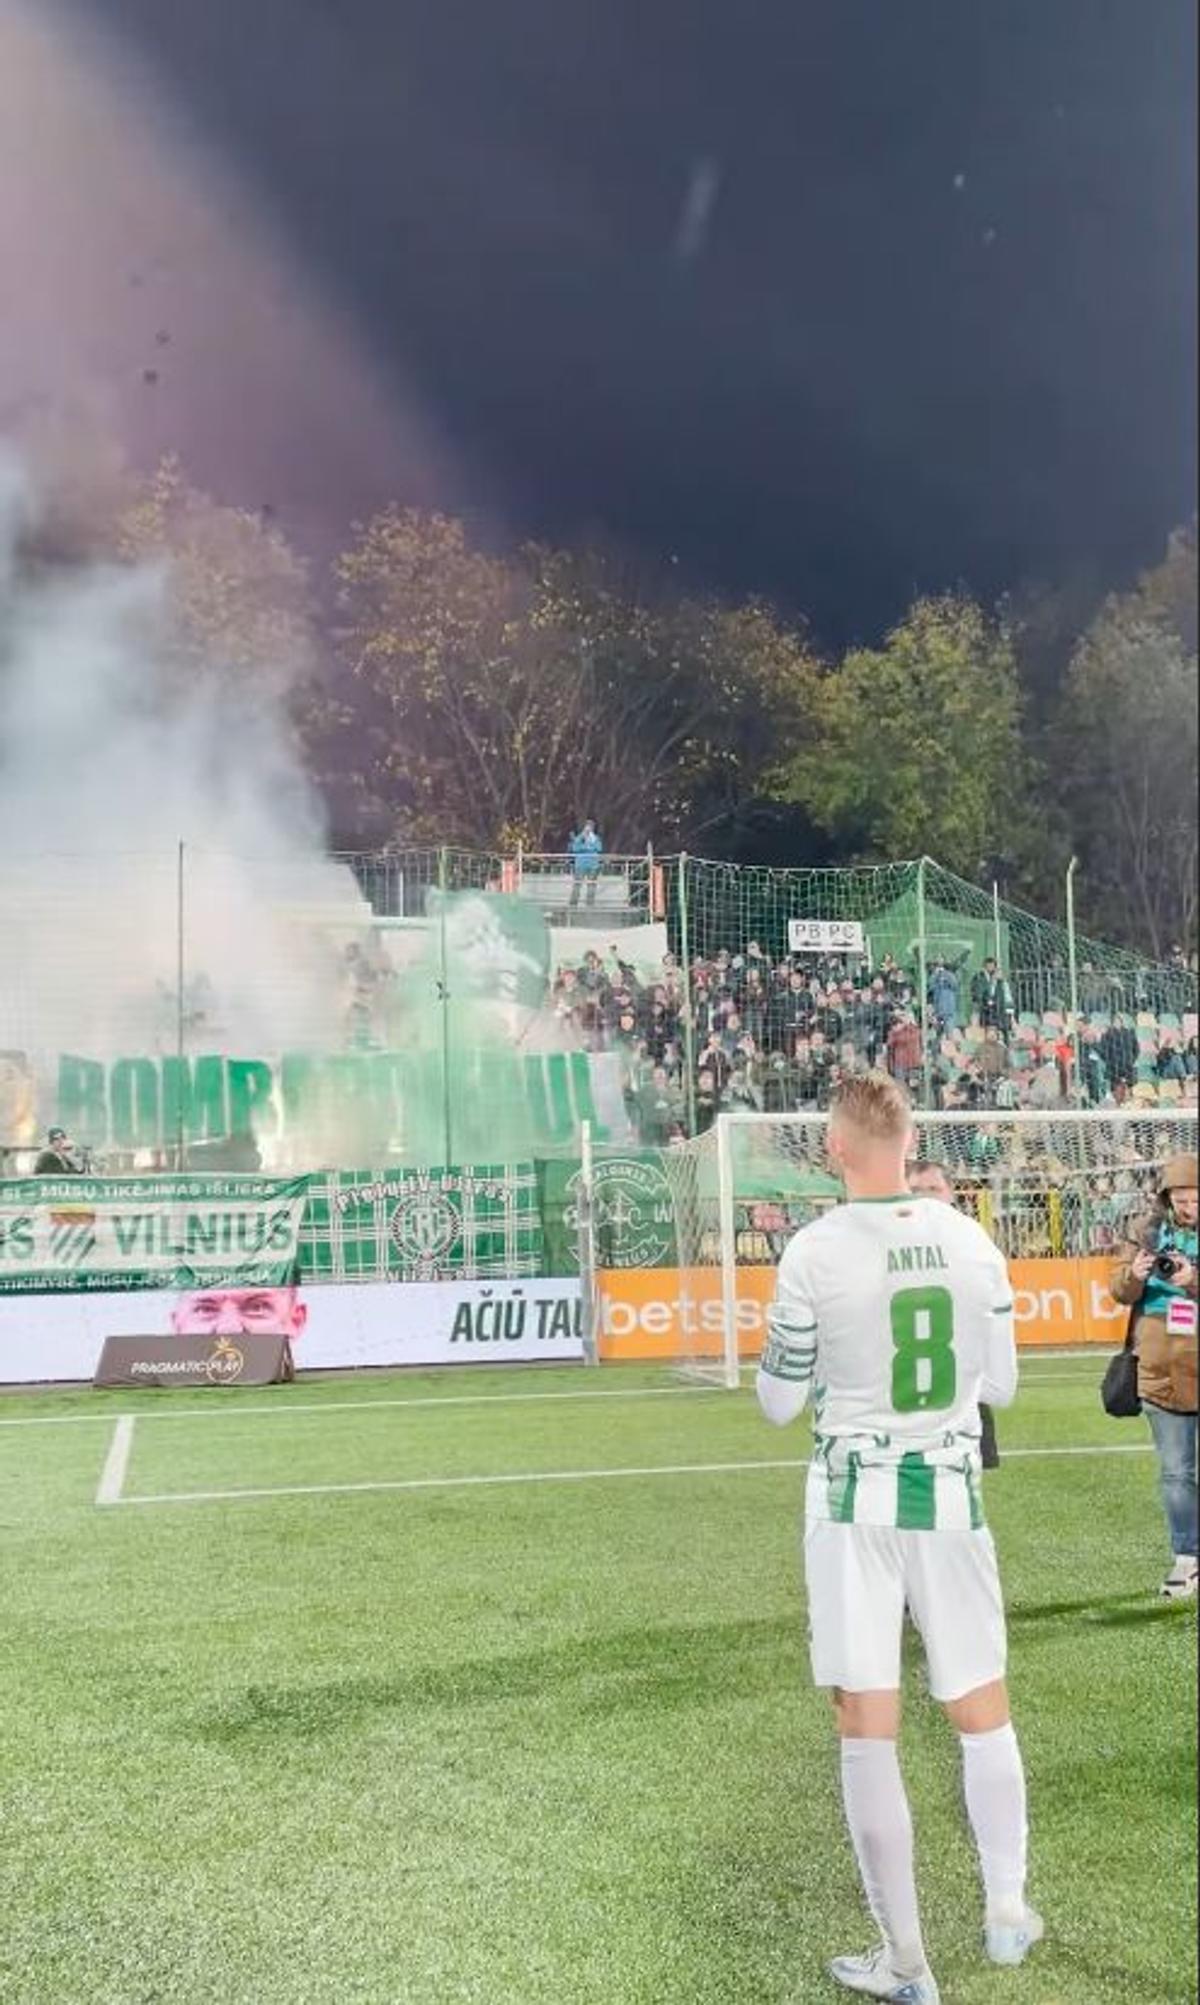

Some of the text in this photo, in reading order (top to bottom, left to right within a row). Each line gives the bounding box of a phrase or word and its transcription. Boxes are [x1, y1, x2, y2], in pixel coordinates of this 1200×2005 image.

[795, 923, 854, 940] PB PC
[112, 1209, 292, 1256] VILNIUS
[887, 1245, 949, 1274] ANTAL
[450, 1289, 527, 1343] AČIŪ
[602, 1293, 774, 1336] betss
[889, 1285, 956, 1414] 8
